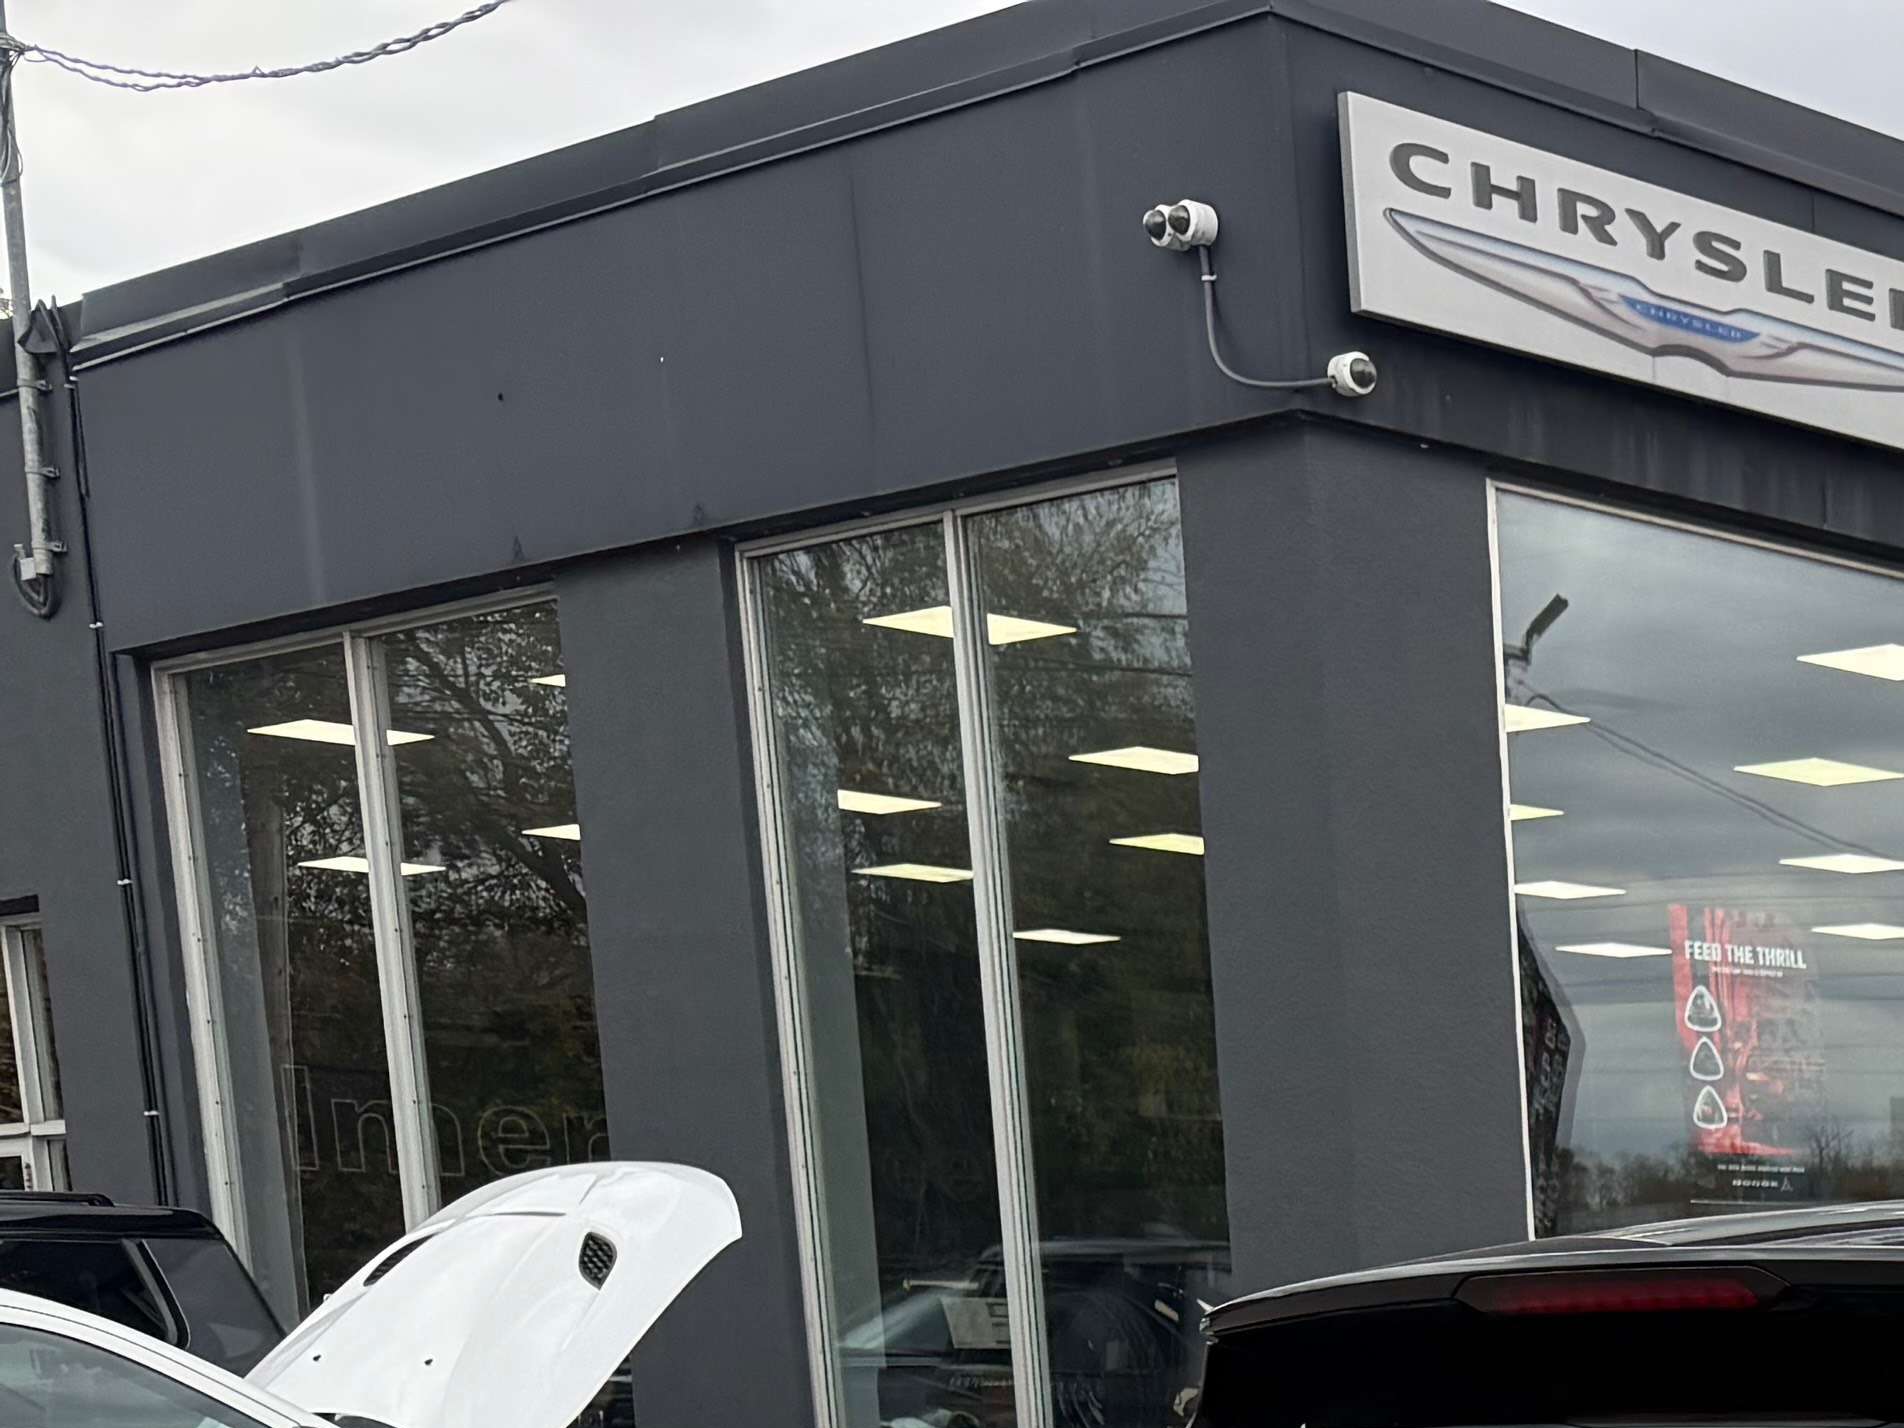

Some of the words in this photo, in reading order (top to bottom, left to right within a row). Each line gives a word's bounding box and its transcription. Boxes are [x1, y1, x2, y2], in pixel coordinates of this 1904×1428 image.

[1684, 940, 1722, 961] FEED
[1725, 943, 1754, 964] THE
[1756, 946, 1807, 969] THRILL
